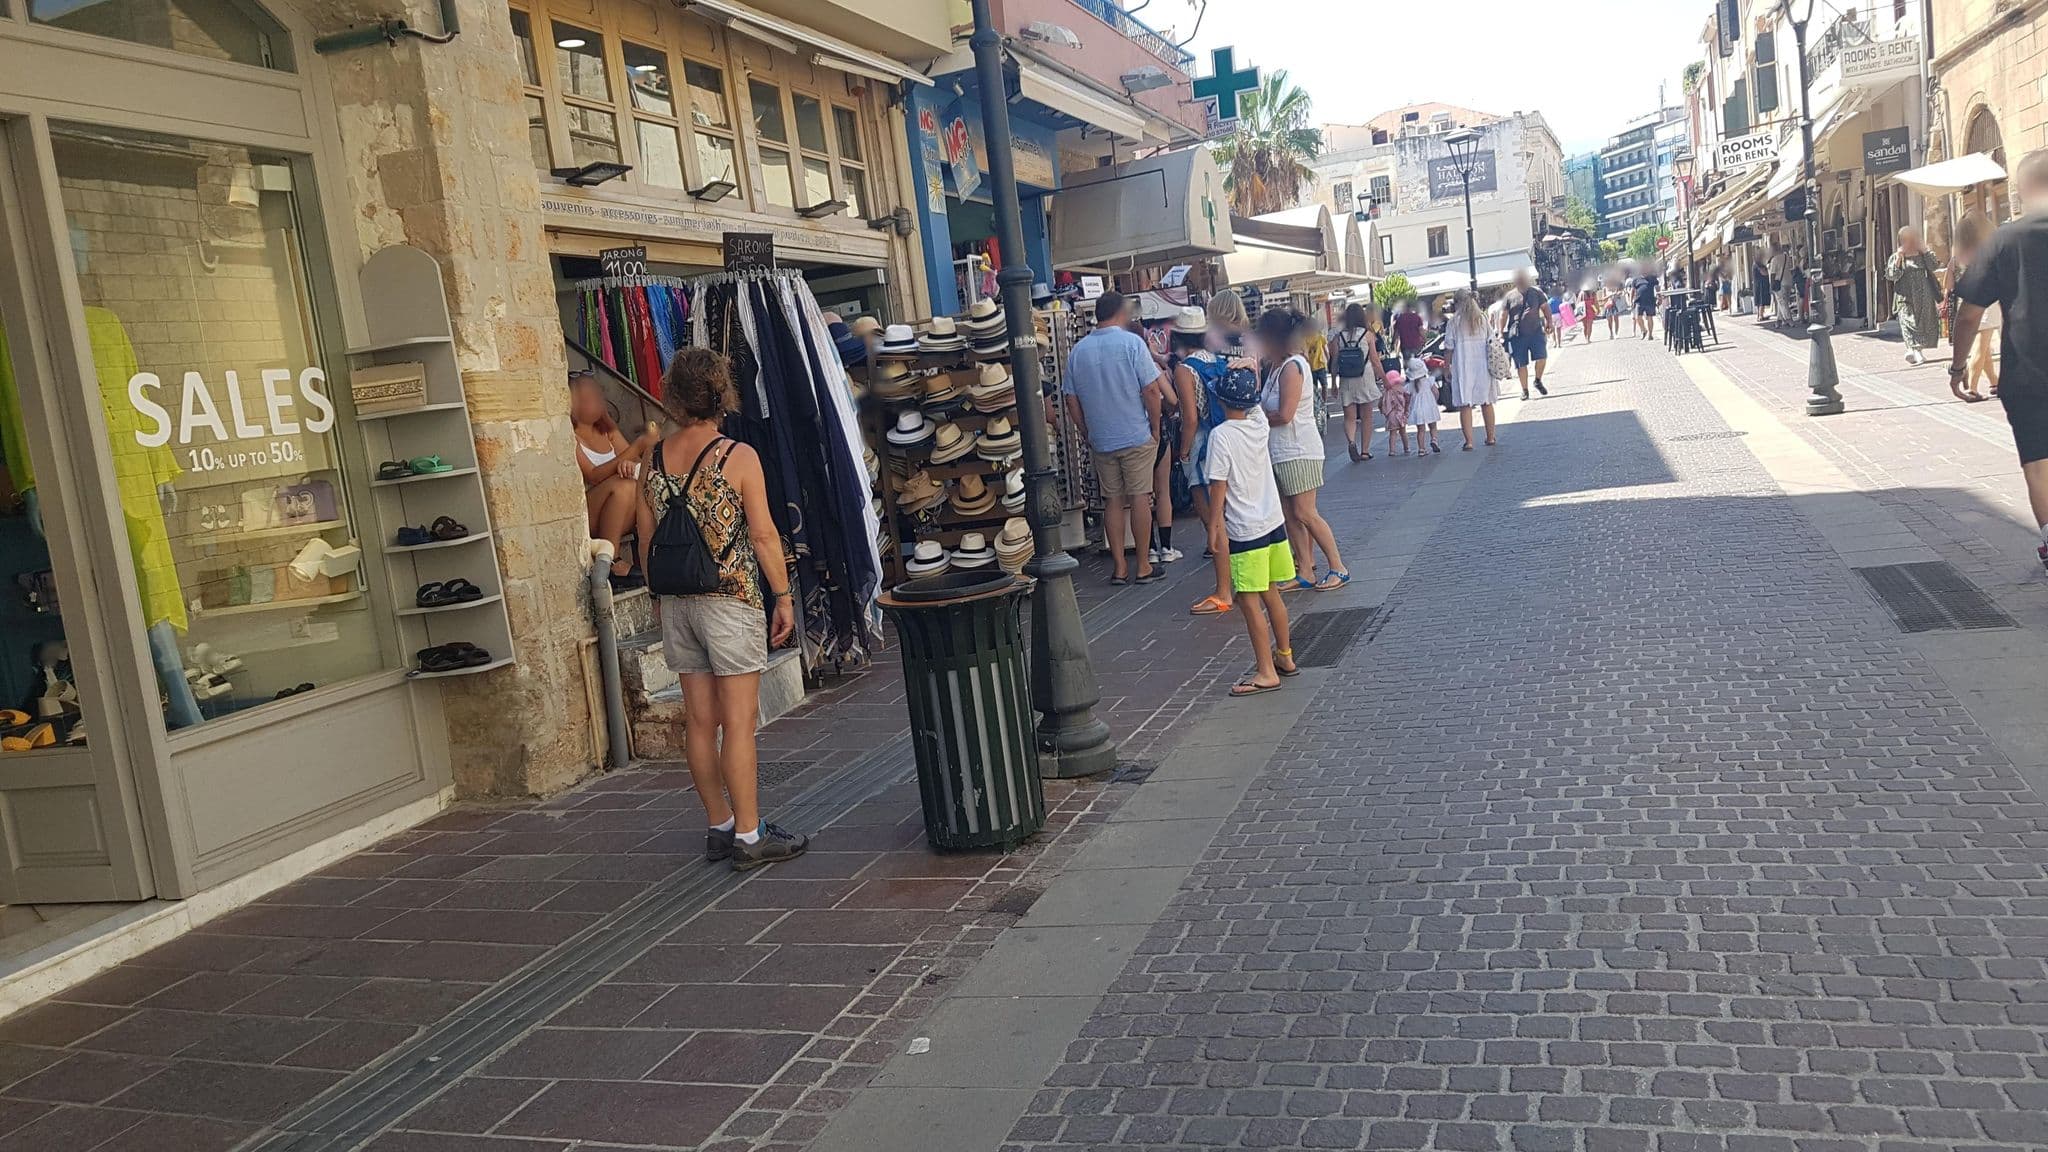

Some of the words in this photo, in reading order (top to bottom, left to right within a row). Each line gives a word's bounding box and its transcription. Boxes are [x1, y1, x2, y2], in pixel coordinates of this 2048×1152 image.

[1844, 47, 1876, 65] ROOMS
[1888, 40, 1913, 56] RENT
[1721, 134, 1773, 155] ROOMS
[1723, 154, 1742, 166] FOR
[1745, 147, 1769, 161] RENT
[600, 206, 658, 225] accessories
[602, 248, 644, 262] SARONG
[729, 238, 772, 256] SARONG
[127, 366, 336, 448] SALES
[187, 447, 225, 473] 10%
[228, 453, 247, 469] UP
[249, 451, 267, 466] TO
[270, 440, 303, 464] 50%
